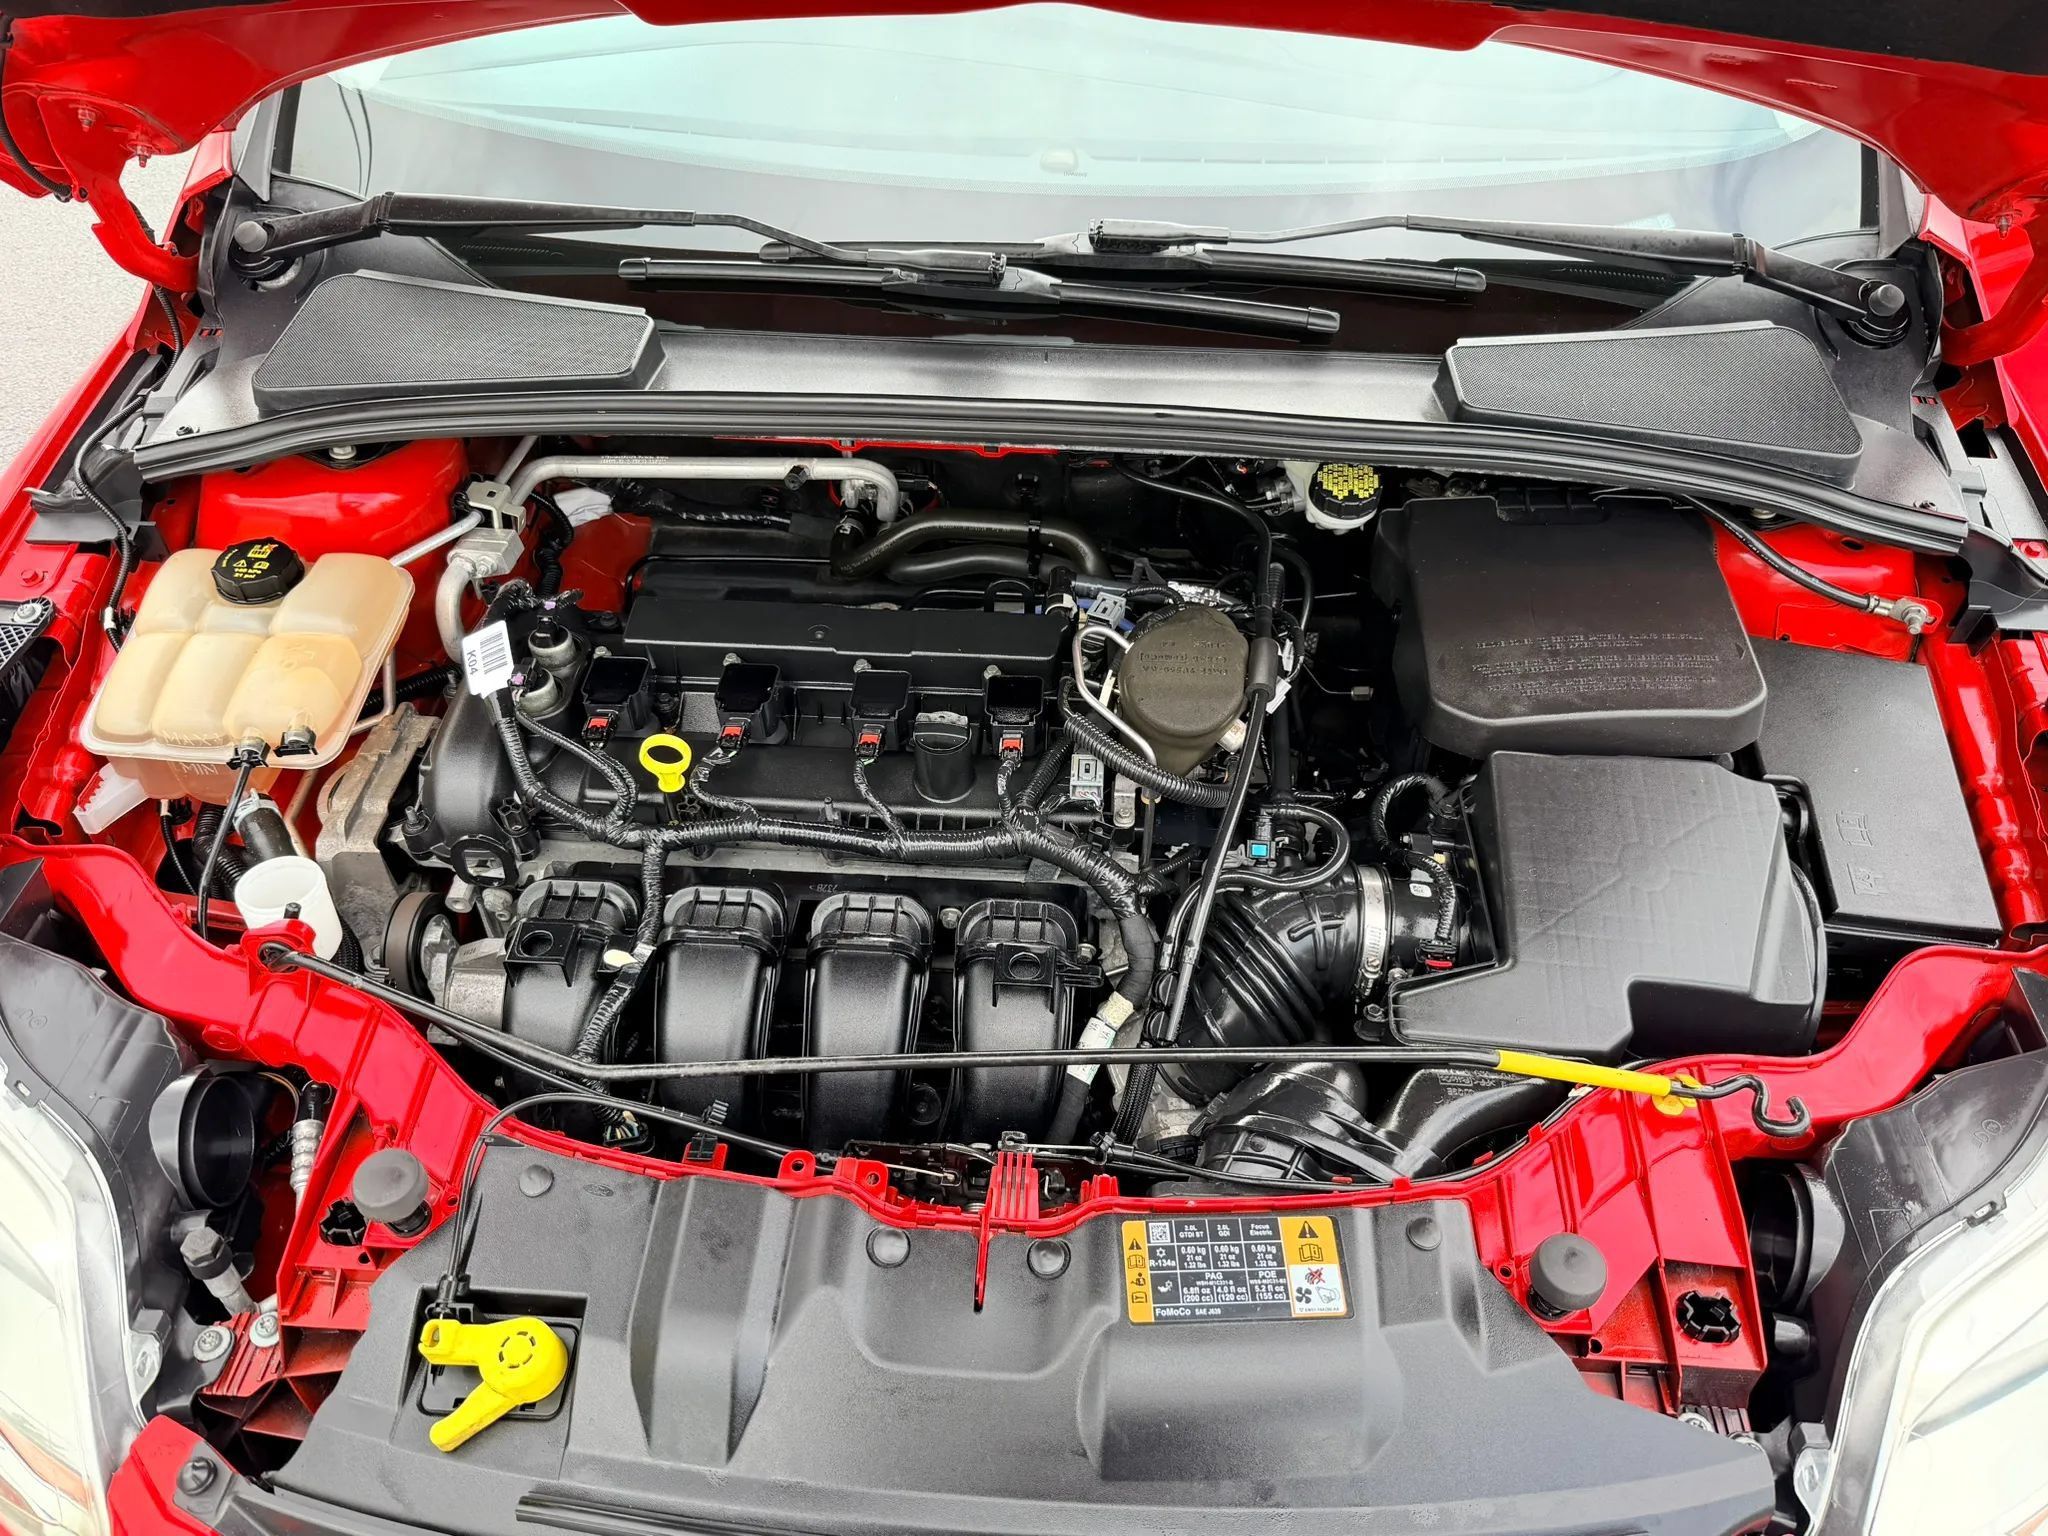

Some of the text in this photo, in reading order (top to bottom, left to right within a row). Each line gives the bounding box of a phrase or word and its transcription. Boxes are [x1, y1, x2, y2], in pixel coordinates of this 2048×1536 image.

[466, 649, 479, 676] K04
[179, 761, 219, 776] MIN
[1181, 1245, 1206, 1255] 0.60 kg
[1214, 1244, 1239, 1254] 0.60 kg
[1251, 1244, 1276, 1254] 0.60 kg
[1150, 1259, 1176, 1267] R-134a
[1205, 1272, 1223, 1280] PAG
[1258, 1270, 1276, 1278] POE
[1217, 1286, 1229, 1294] 4.0
[1230, 1285, 1236, 1293] fl
[1255, 1285, 1267, 1293] 5.2
[1183, 1293, 1213, 1303] (200 cc)
[1218, 1293, 1248, 1302] (120 cc)
[1256, 1292, 1286, 1301] (155 cc)
[1156, 1308, 1191, 1317] FoMoCo
